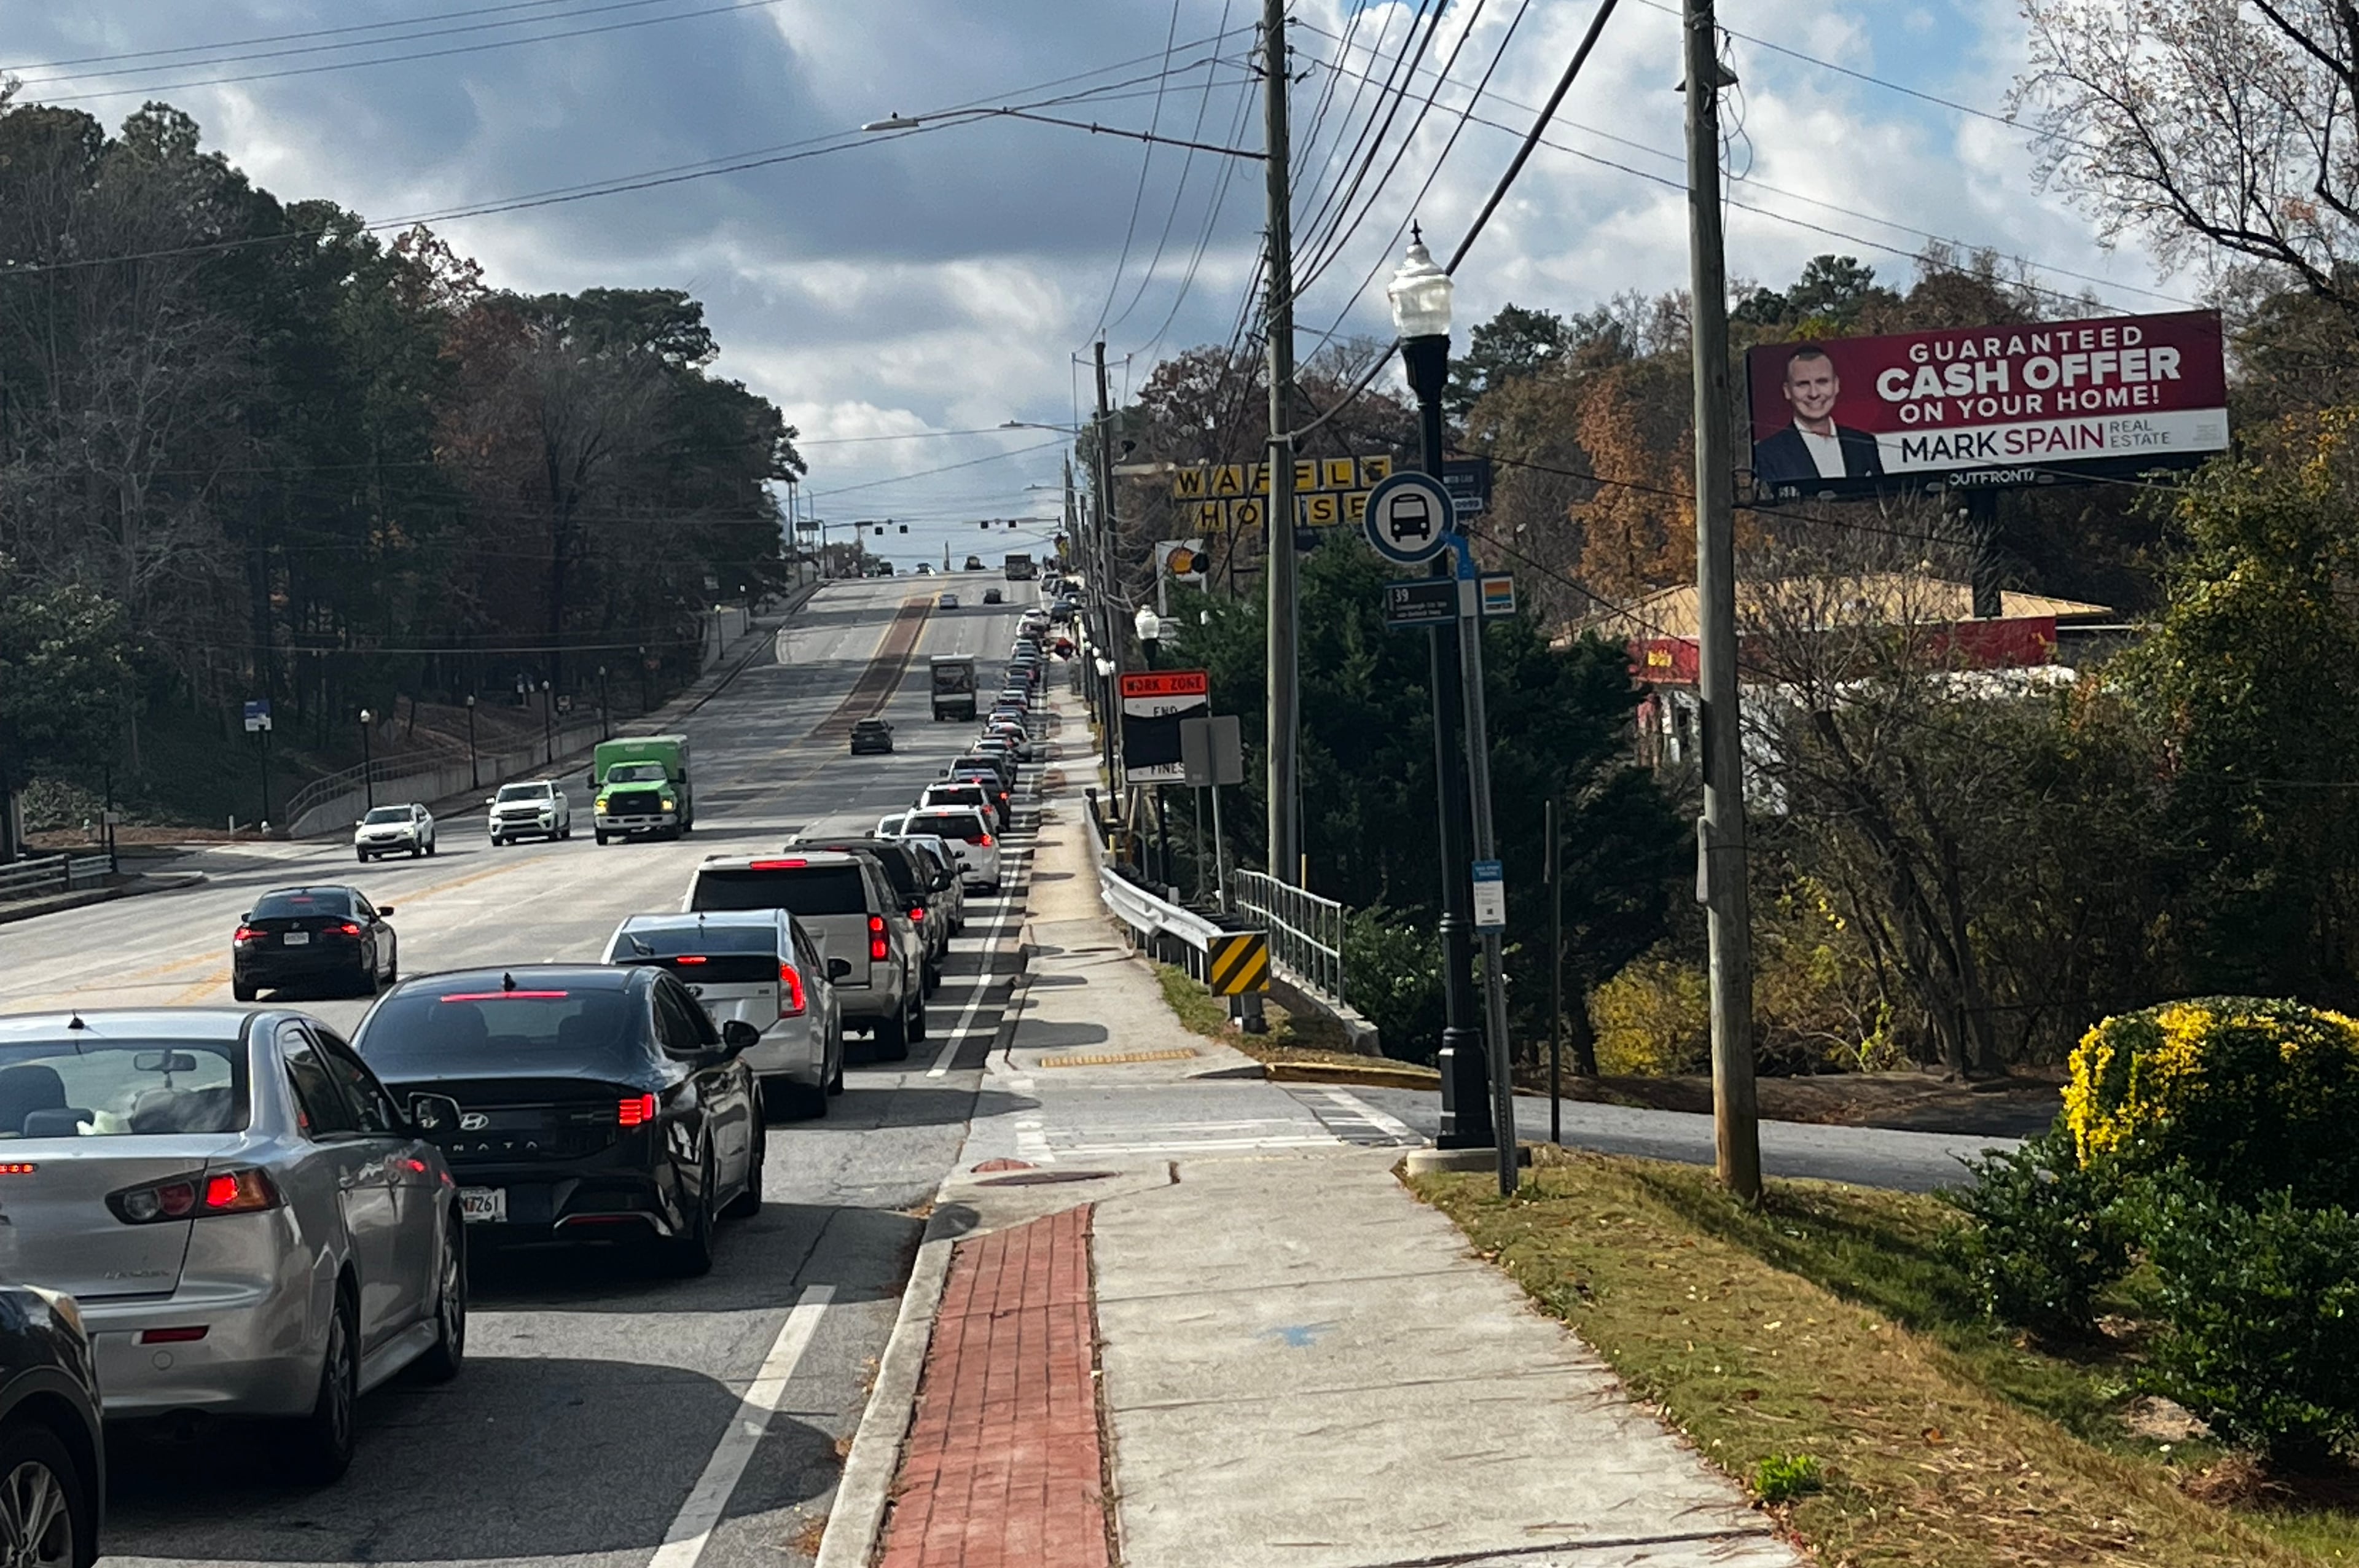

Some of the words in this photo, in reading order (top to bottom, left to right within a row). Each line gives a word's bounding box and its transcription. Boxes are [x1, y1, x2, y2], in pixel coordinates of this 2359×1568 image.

[1909, 326, 2142, 363] GUARANTEED
[1877, 359, 2009, 402] CASH
[2023, 346, 2181, 389] OFFER
[1899, 402, 1943, 423] ON
[1957, 394, 2043, 419] YOUR
[2057, 385, 2159, 412] HOME!
[2110, 419, 2153, 433] REAL
[2110, 432, 2171, 448] ESTATE
[1902, 431, 1998, 462] MARK
[2005, 423, 2103, 455] SPAIN
[1201, 497, 1366, 526] HOSE
[1395, 588, 1409, 603] 39
[1127, 681, 1160, 692] WORK
[1171, 676, 1202, 690] ZONE
